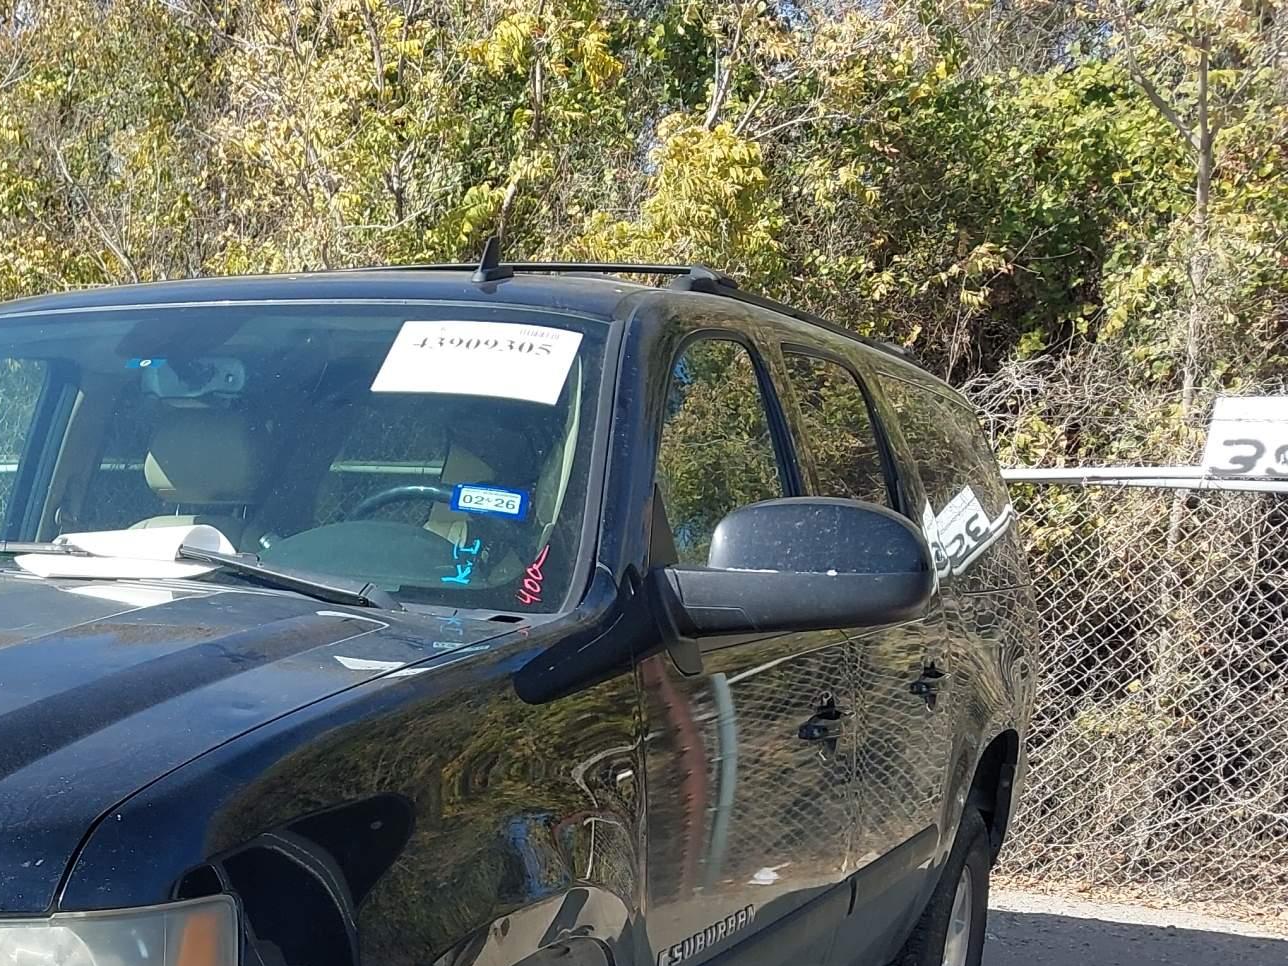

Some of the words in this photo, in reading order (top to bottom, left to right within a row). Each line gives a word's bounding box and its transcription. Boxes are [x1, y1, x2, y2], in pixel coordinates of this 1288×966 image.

[413, 336, 553, 356] 43909305
[462, 494, 485, 506] 02
[494, 498, 516, 510] 26
[669, 904, 756, 966] SUBURBAN
